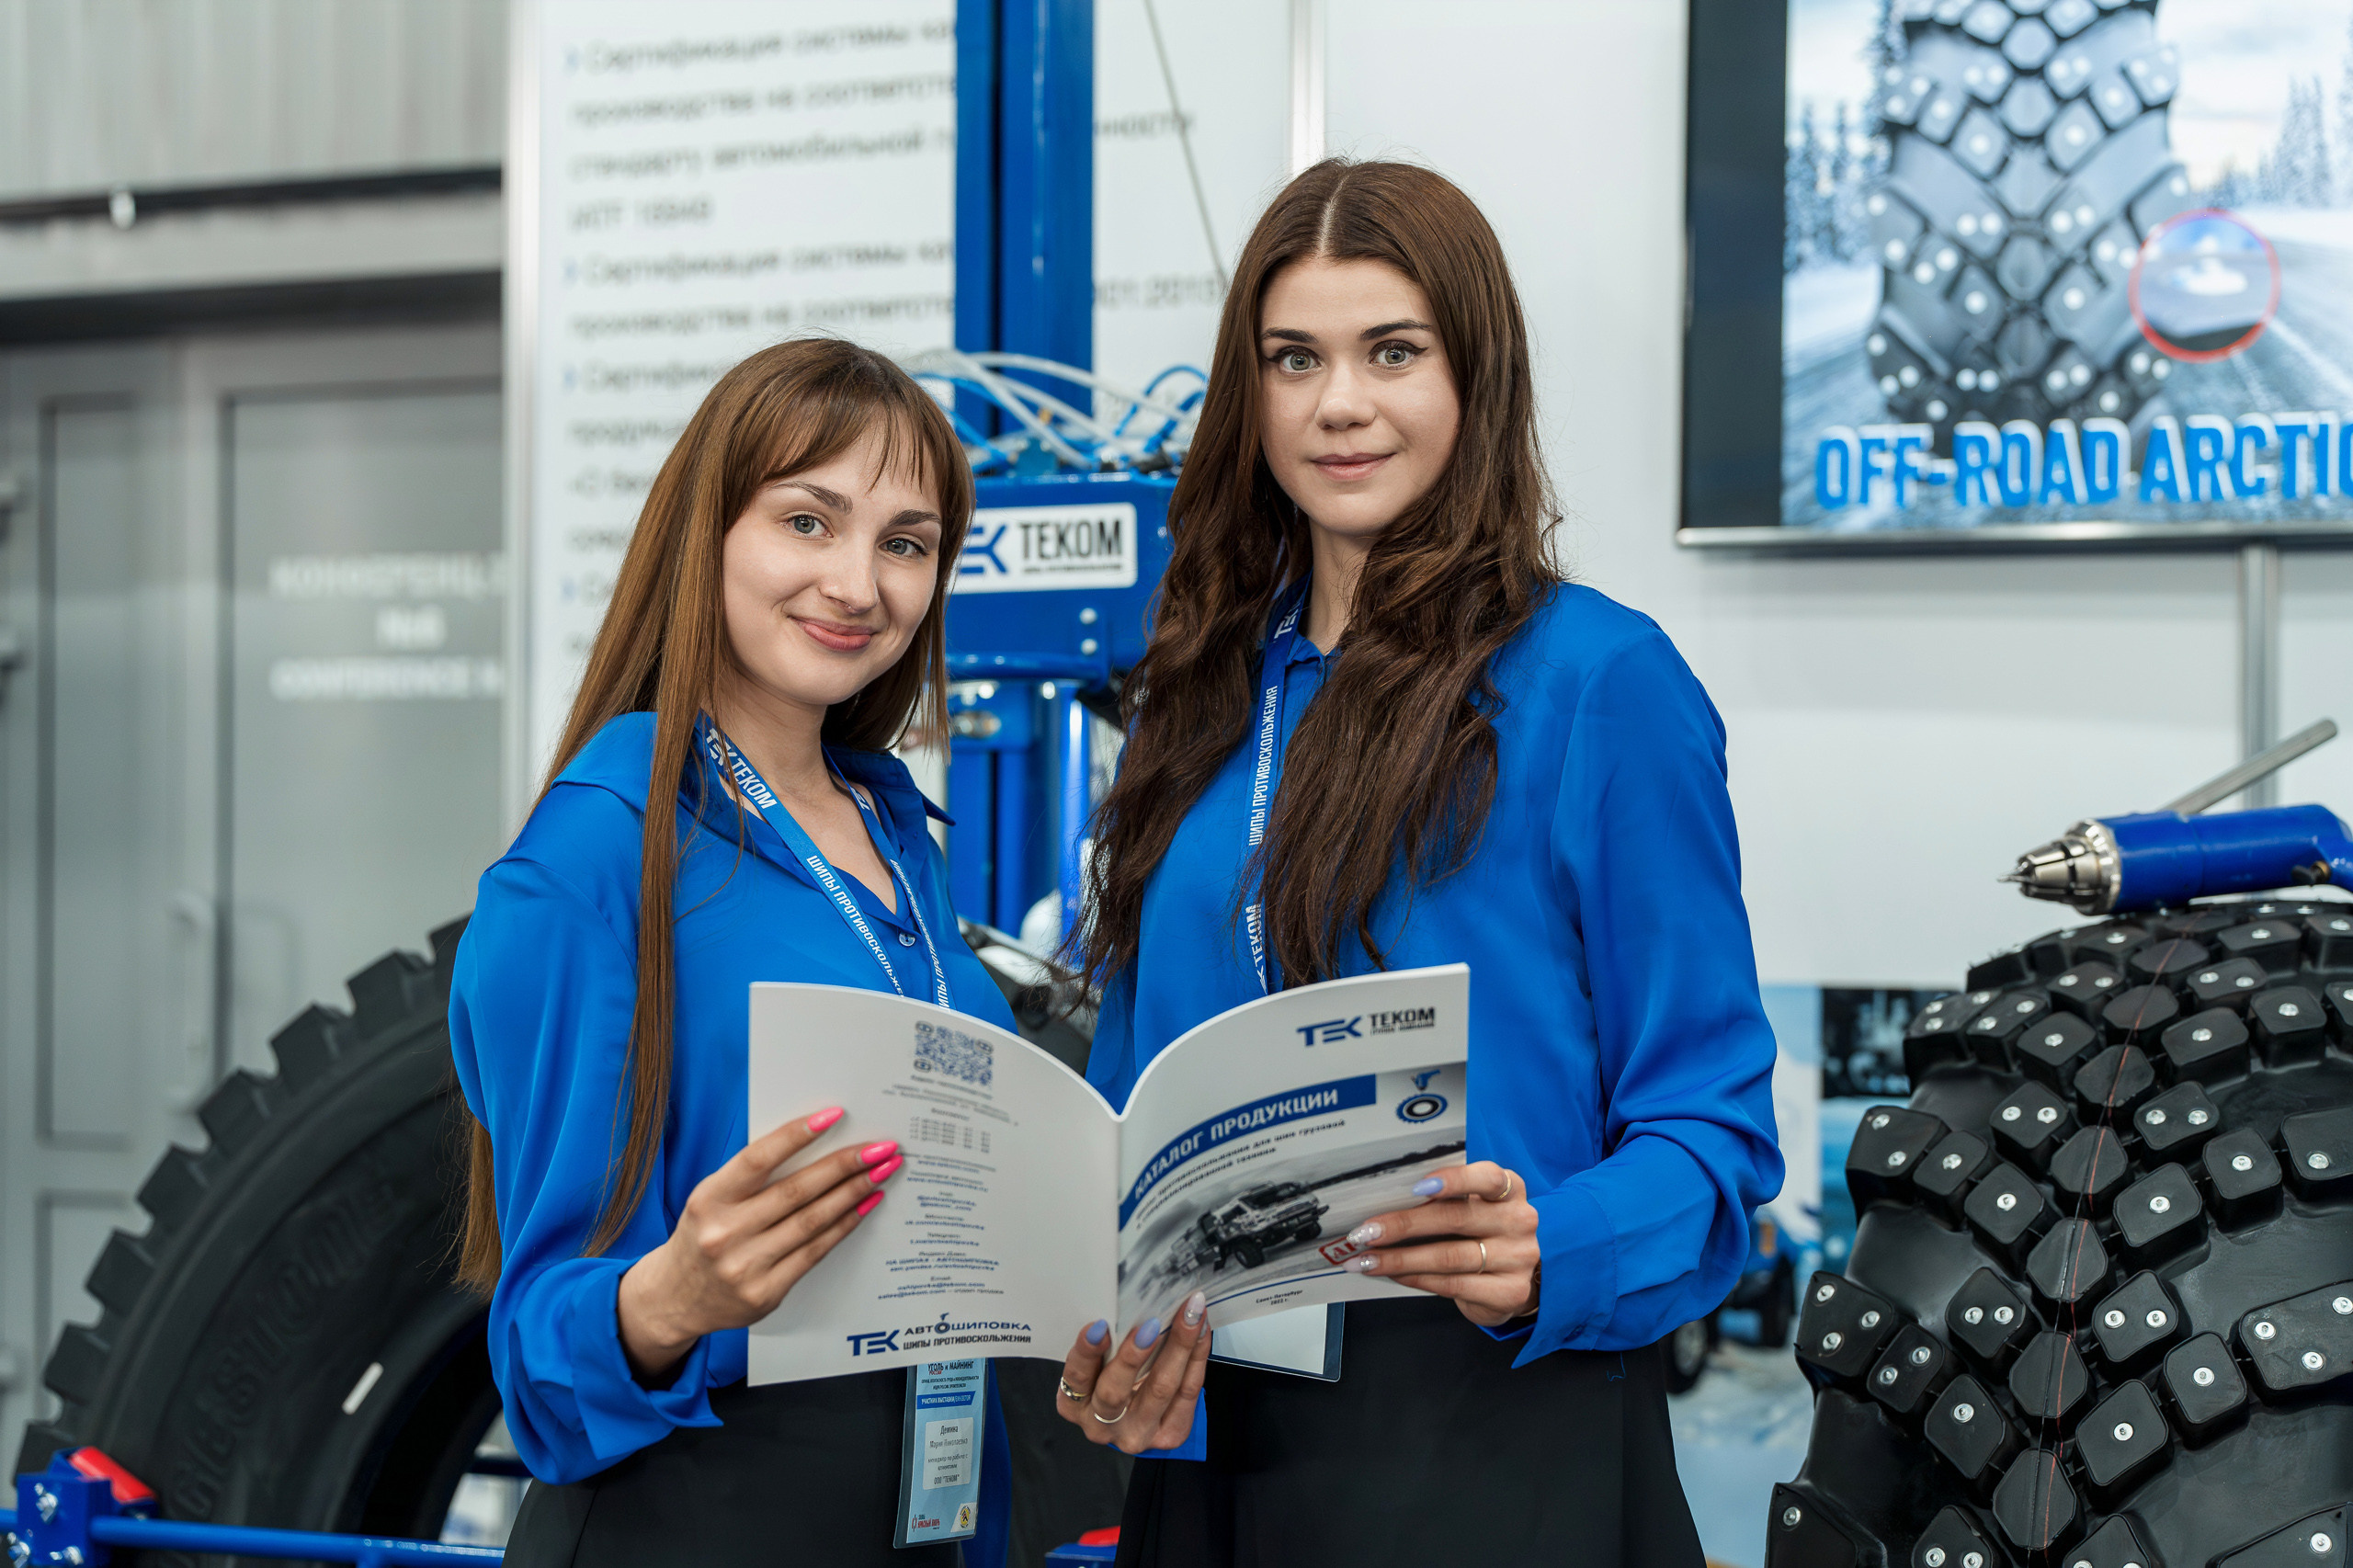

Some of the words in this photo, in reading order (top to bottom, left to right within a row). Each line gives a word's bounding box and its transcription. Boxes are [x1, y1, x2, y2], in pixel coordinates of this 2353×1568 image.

[1816, 418, 2132, 510] OFF-ROAD
[1018, 519, 1123, 560] ТЕКОМ
[1253, 686, 1278, 807] ПРОТИВОСКОЛЬЖЕНИЯ
[732, 757, 778, 809] ТЕКОМ
[1249, 808, 1267, 846] ШИПЫ
[806, 855, 841, 892] ШИПЫ
[834, 891, 904, 998] ПРОТИВОСКОЛЬЖЕ
[938, 978, 950, 1012] ИПЫ
[1369, 1006, 1436, 1028] ТЕКОМ
[1134, 1131, 1204, 1199] КАТАЛОГ
[1210, 1088, 1339, 1142] ПРОДУКЦИИ
[903, 1339, 931, 1351] ШИПЫ
[933, 1334, 1031, 1346] ПРОТИВОСКОЛЬЖЕНИЯ
[904, 1320, 1031, 1336] АВТОШИПОВКА
[927, 1362, 944, 1372] УГОЛЬ
[949, 1359, 974, 1369] МАЙНИНГ
